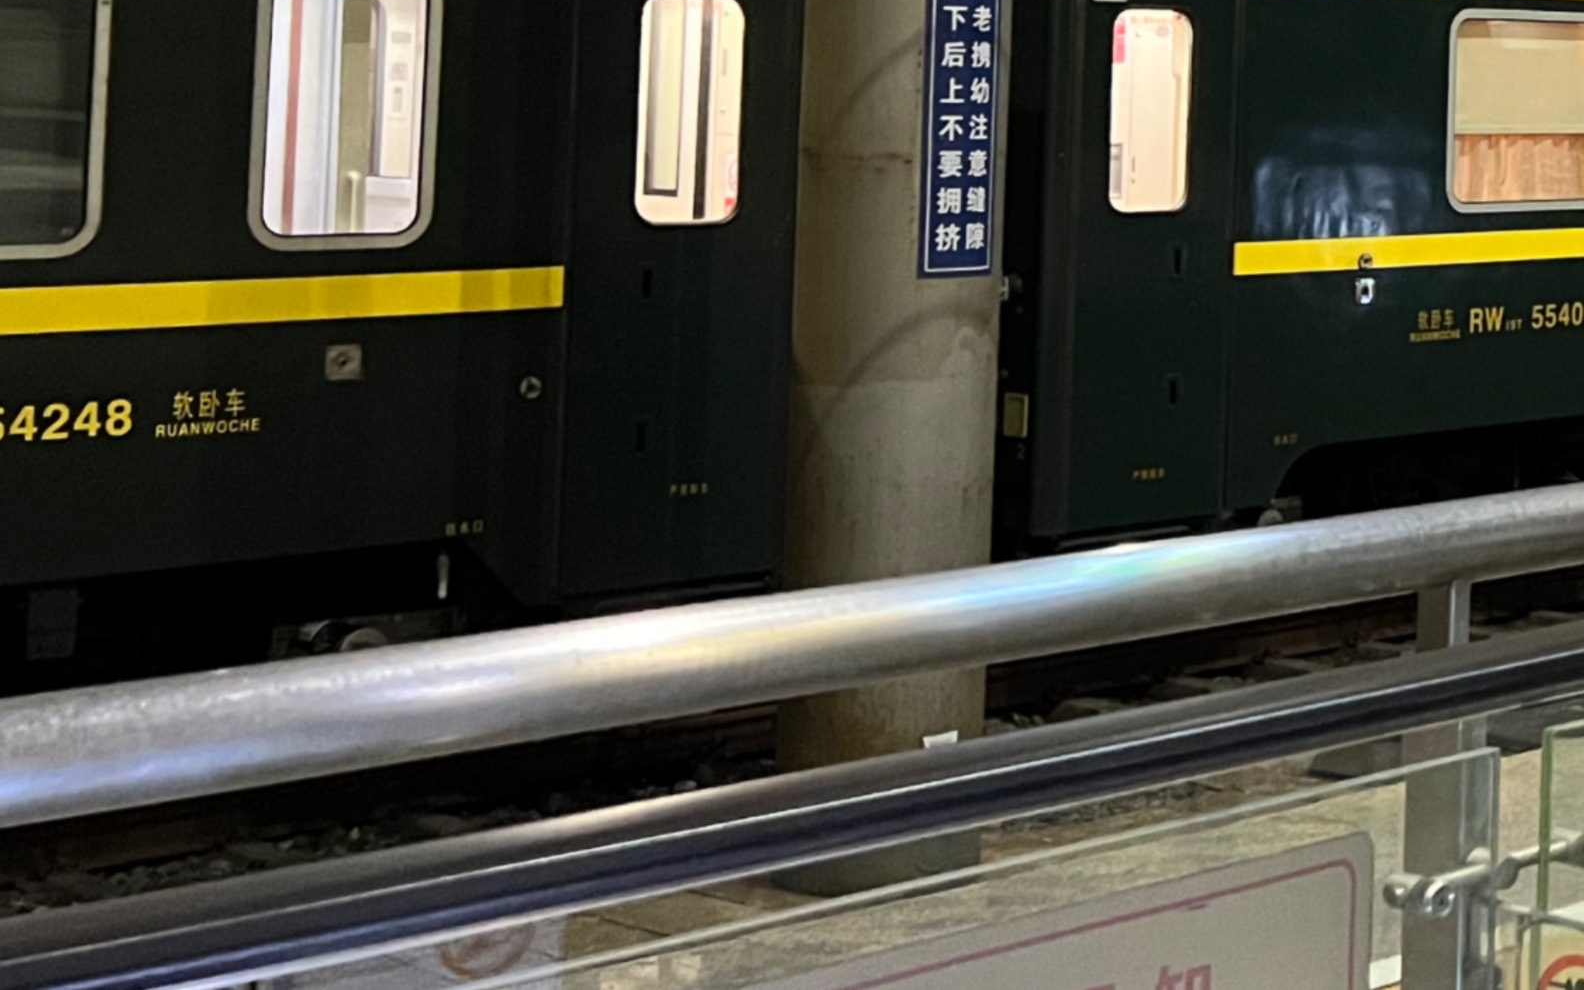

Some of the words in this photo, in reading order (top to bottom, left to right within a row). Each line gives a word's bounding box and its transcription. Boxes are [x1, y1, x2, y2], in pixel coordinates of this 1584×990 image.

[0, 398, 133, 442] 4248
[173, 388, 246, 421] 软卧车
[155, 417, 262, 438] RUANWOCHE
